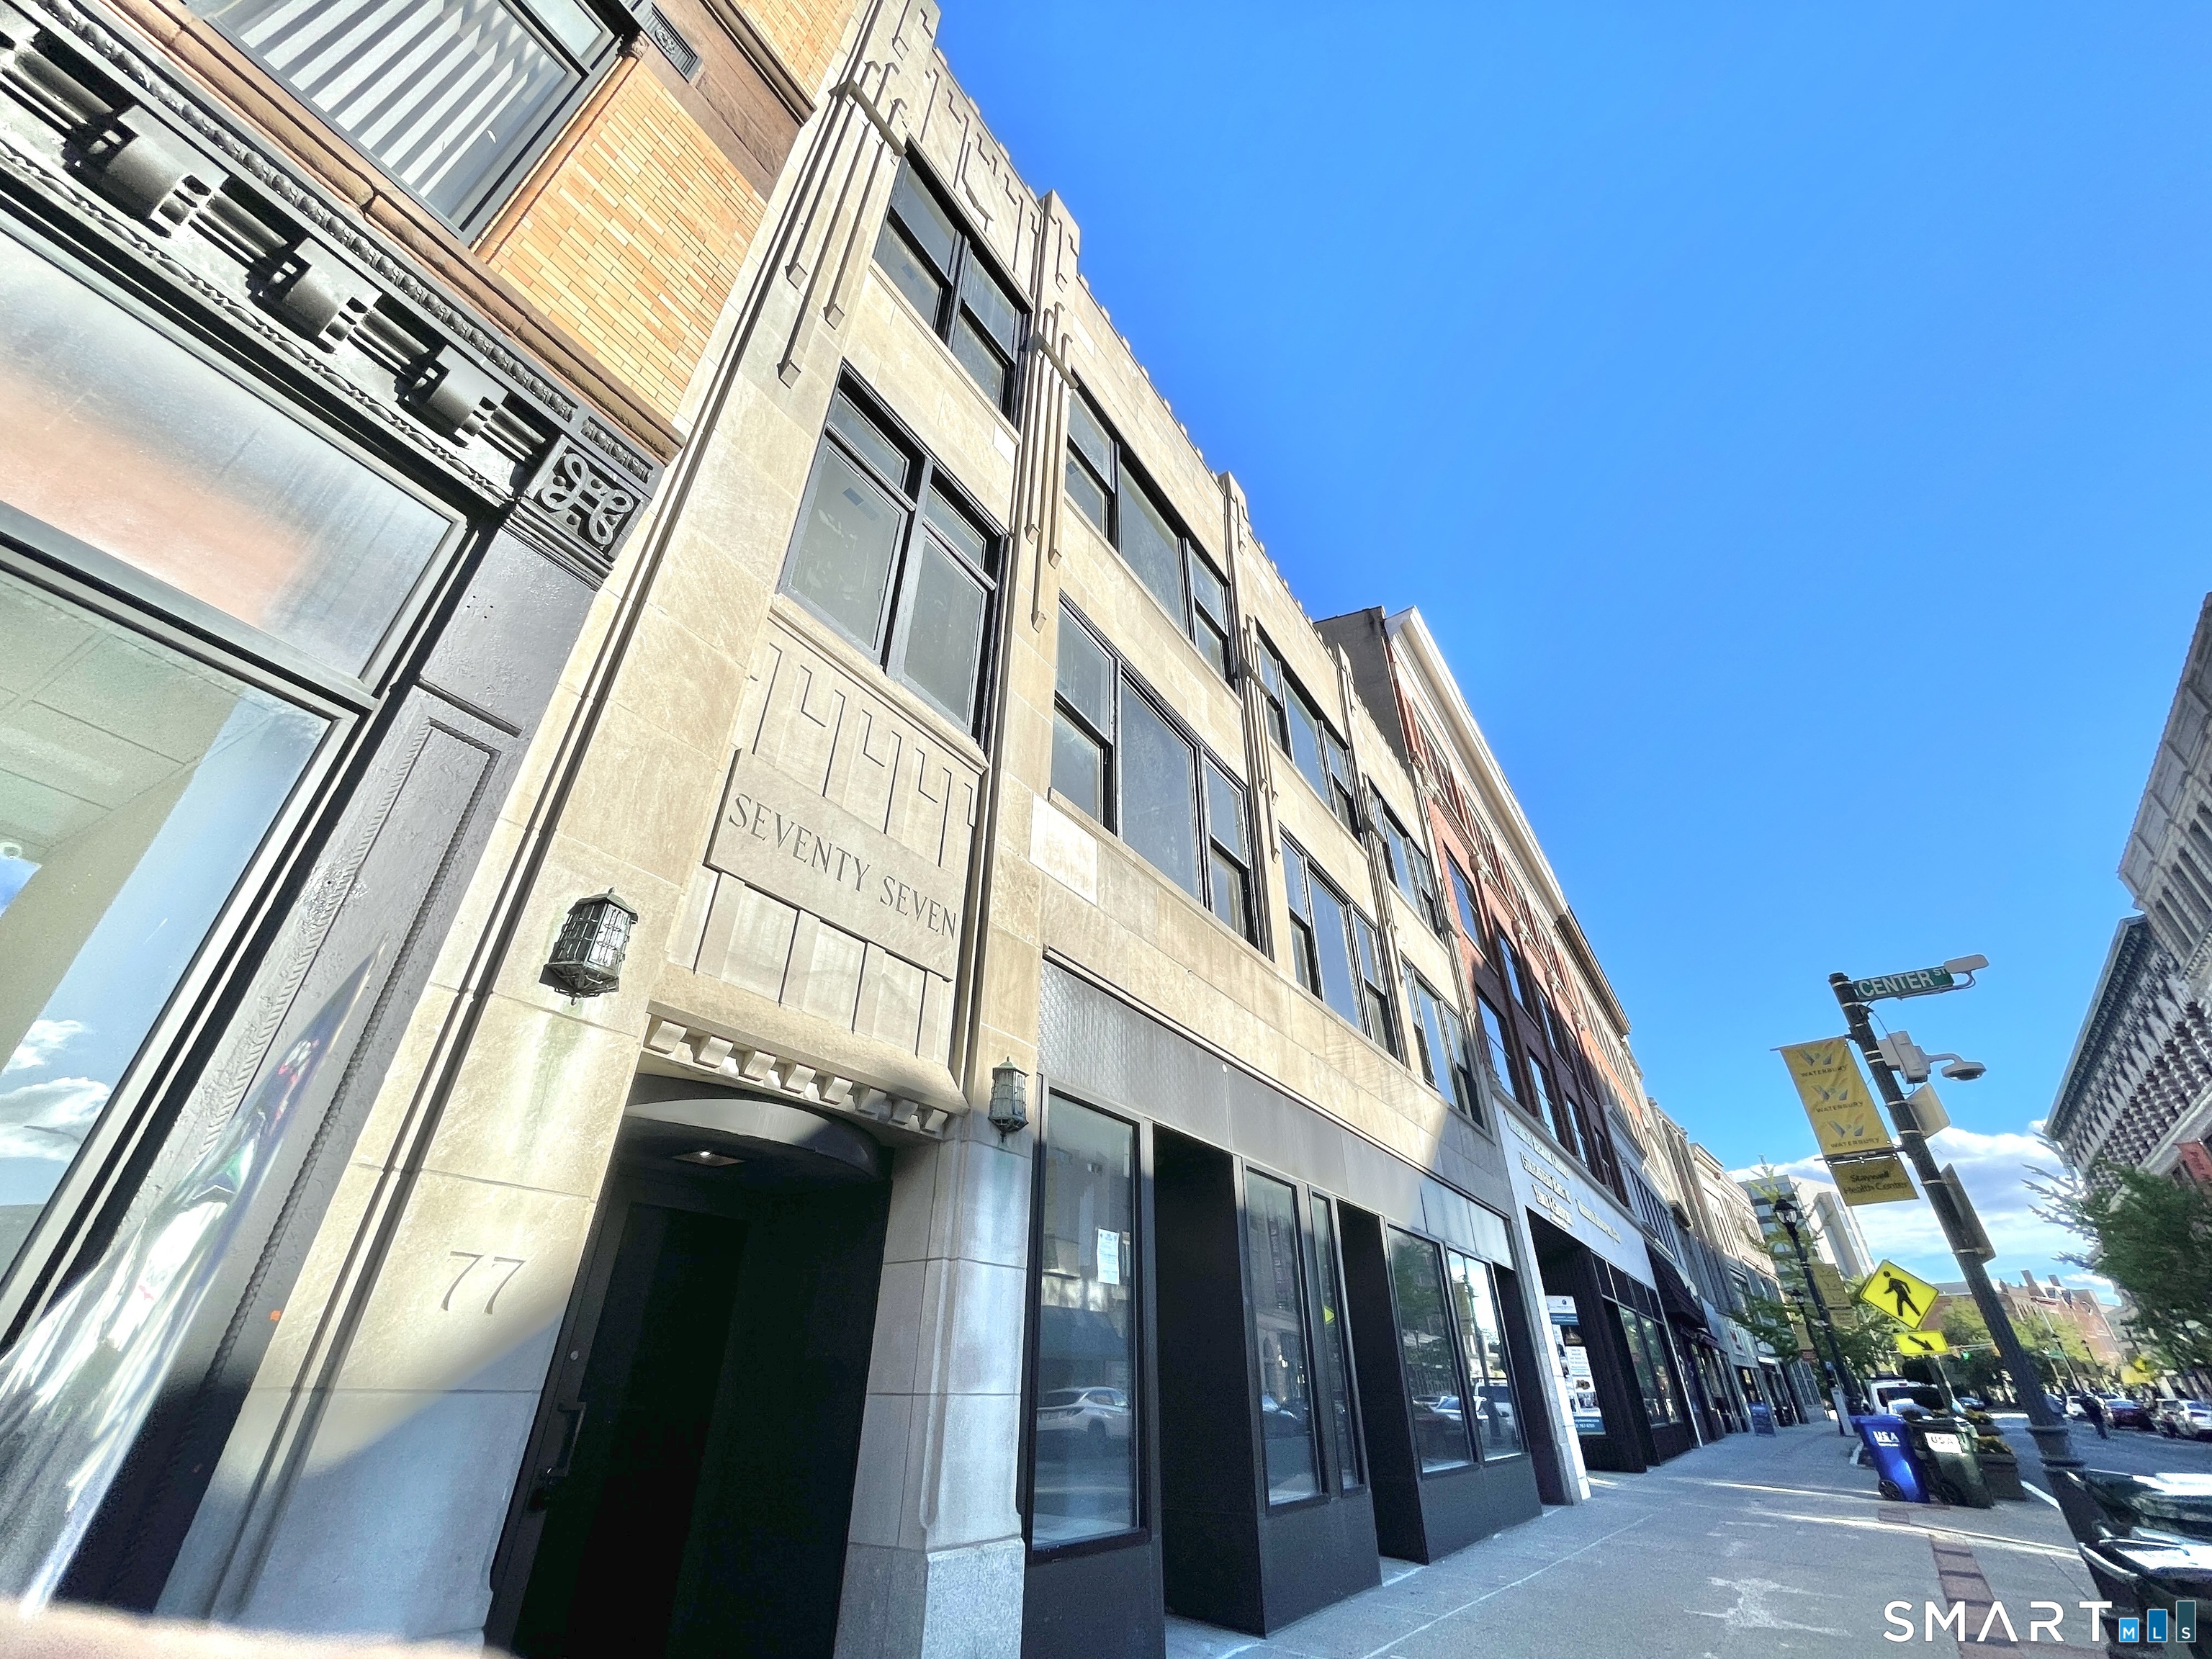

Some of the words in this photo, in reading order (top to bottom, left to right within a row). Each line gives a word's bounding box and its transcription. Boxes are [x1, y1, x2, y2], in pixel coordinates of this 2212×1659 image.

[729, 793, 871, 892] SEVENTY
[879, 876, 957, 940] SEVEN
[1858, 970, 1935, 997] CENTER
[1933, 968, 1946, 976] ST
[1800, 1064, 1848, 1077] WATERBURY
[1815, 1101, 1863, 1113] WATERBURY
[1830, 1137, 1880, 1148] WATERBURY
[1843, 1184, 1874, 1195] Health
[1875, 1182, 1908, 1190] Center
[440, 1251, 526, 1315] 77
[1873, 1431, 1899, 1442] USA
[1930, 1436, 1954, 1445] USA
